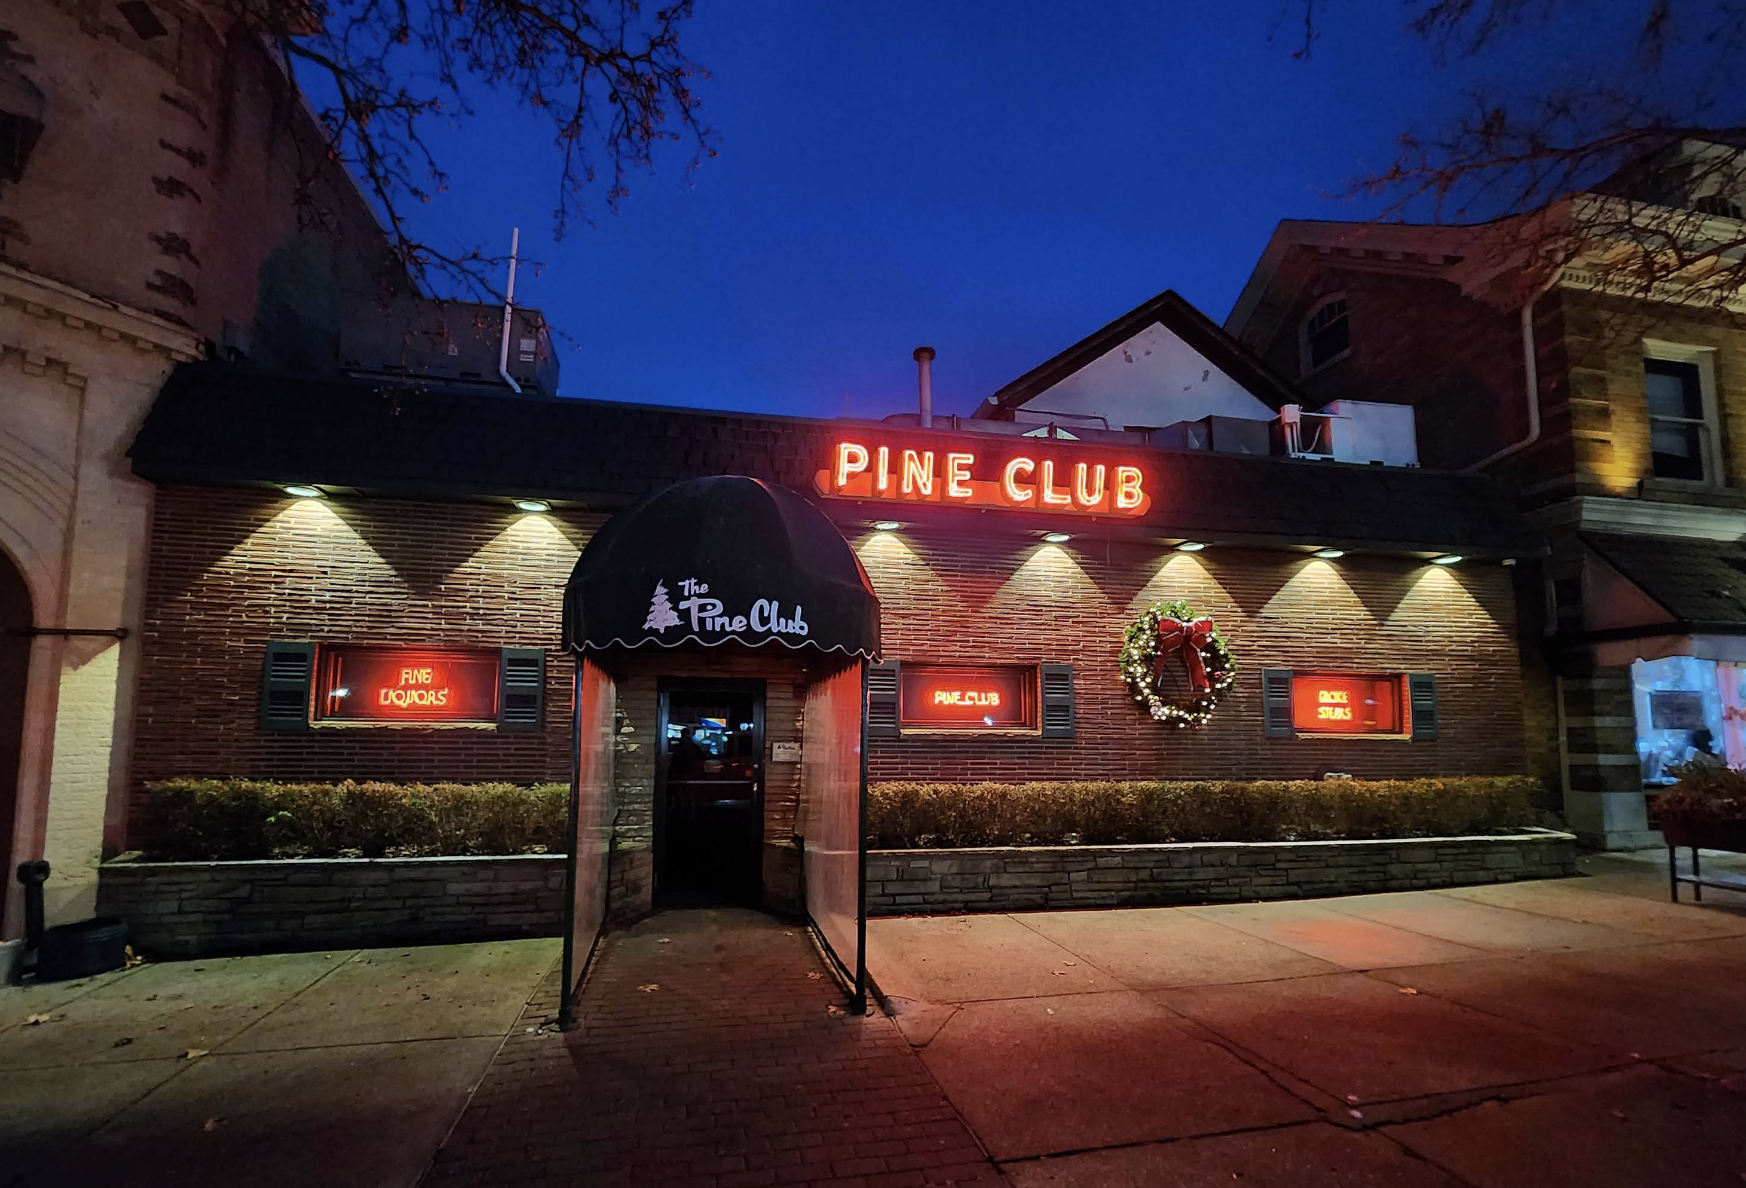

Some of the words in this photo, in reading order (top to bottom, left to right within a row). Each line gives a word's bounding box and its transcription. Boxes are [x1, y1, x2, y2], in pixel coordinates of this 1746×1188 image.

[832, 443, 974, 497] PINE
[1002, 457, 1144, 509] CLUB
[678, 577, 709, 596] The
[679, 597, 747, 632] Pine
[750, 598, 809, 636] Club
[400, 668, 433, 686] FINE
[379, 688, 449, 708] LIQUORS
[934, 691, 961, 705] PINE
[965, 691, 1000, 706] CLUB
